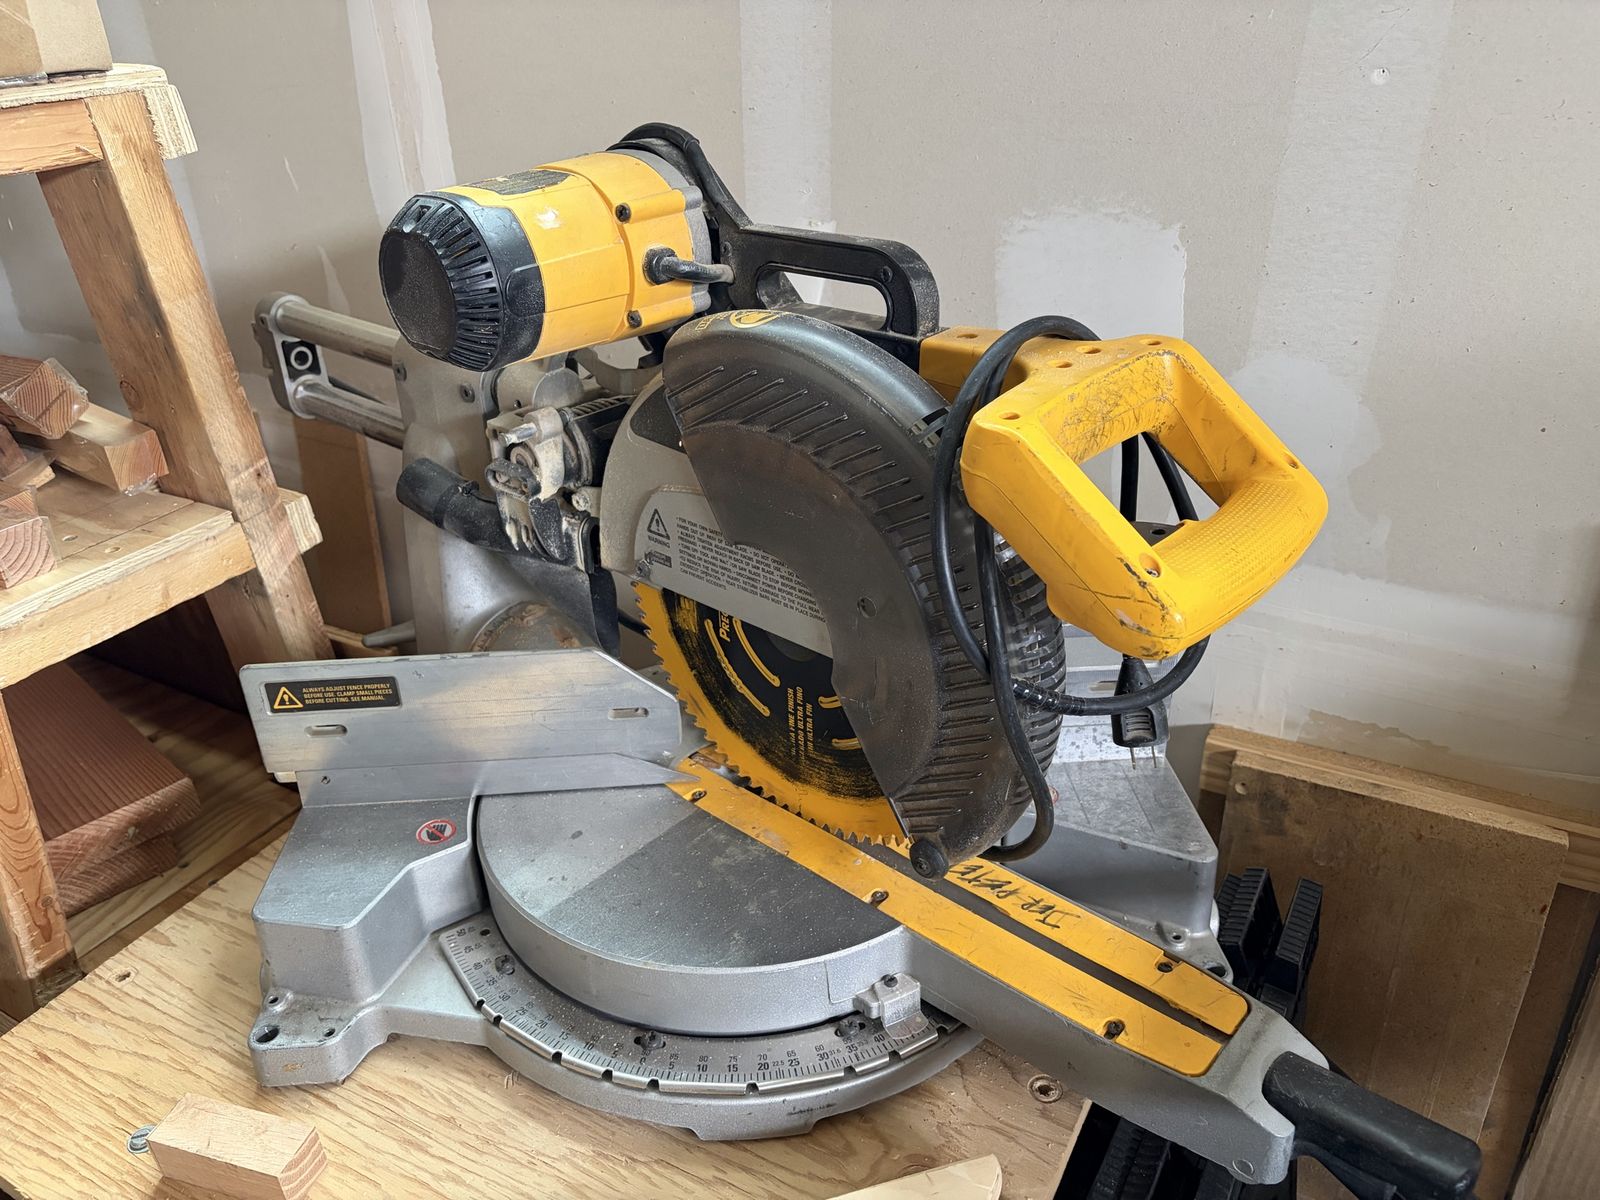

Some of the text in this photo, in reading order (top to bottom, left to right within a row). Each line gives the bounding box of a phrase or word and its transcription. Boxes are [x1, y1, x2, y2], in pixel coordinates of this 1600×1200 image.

[457, 928, 466, 937] 50
[499, 993, 510, 1001] 30
[516, 1007, 527, 1016] 25
[536, 1020, 548, 1029] 20
[559, 1031, 570, 1040] 15
[584, 1042, 594, 1050] 10
[727, 1064, 738, 1072] 15
[758, 1063, 769, 1071] 20
[788, 1058, 800, 1066] 25
[816, 1052, 829, 1061] 30
[846, 1044, 858, 1053] 35
[873, 1034, 885, 1043] 40
[815, 1044, 824, 1052] 60
